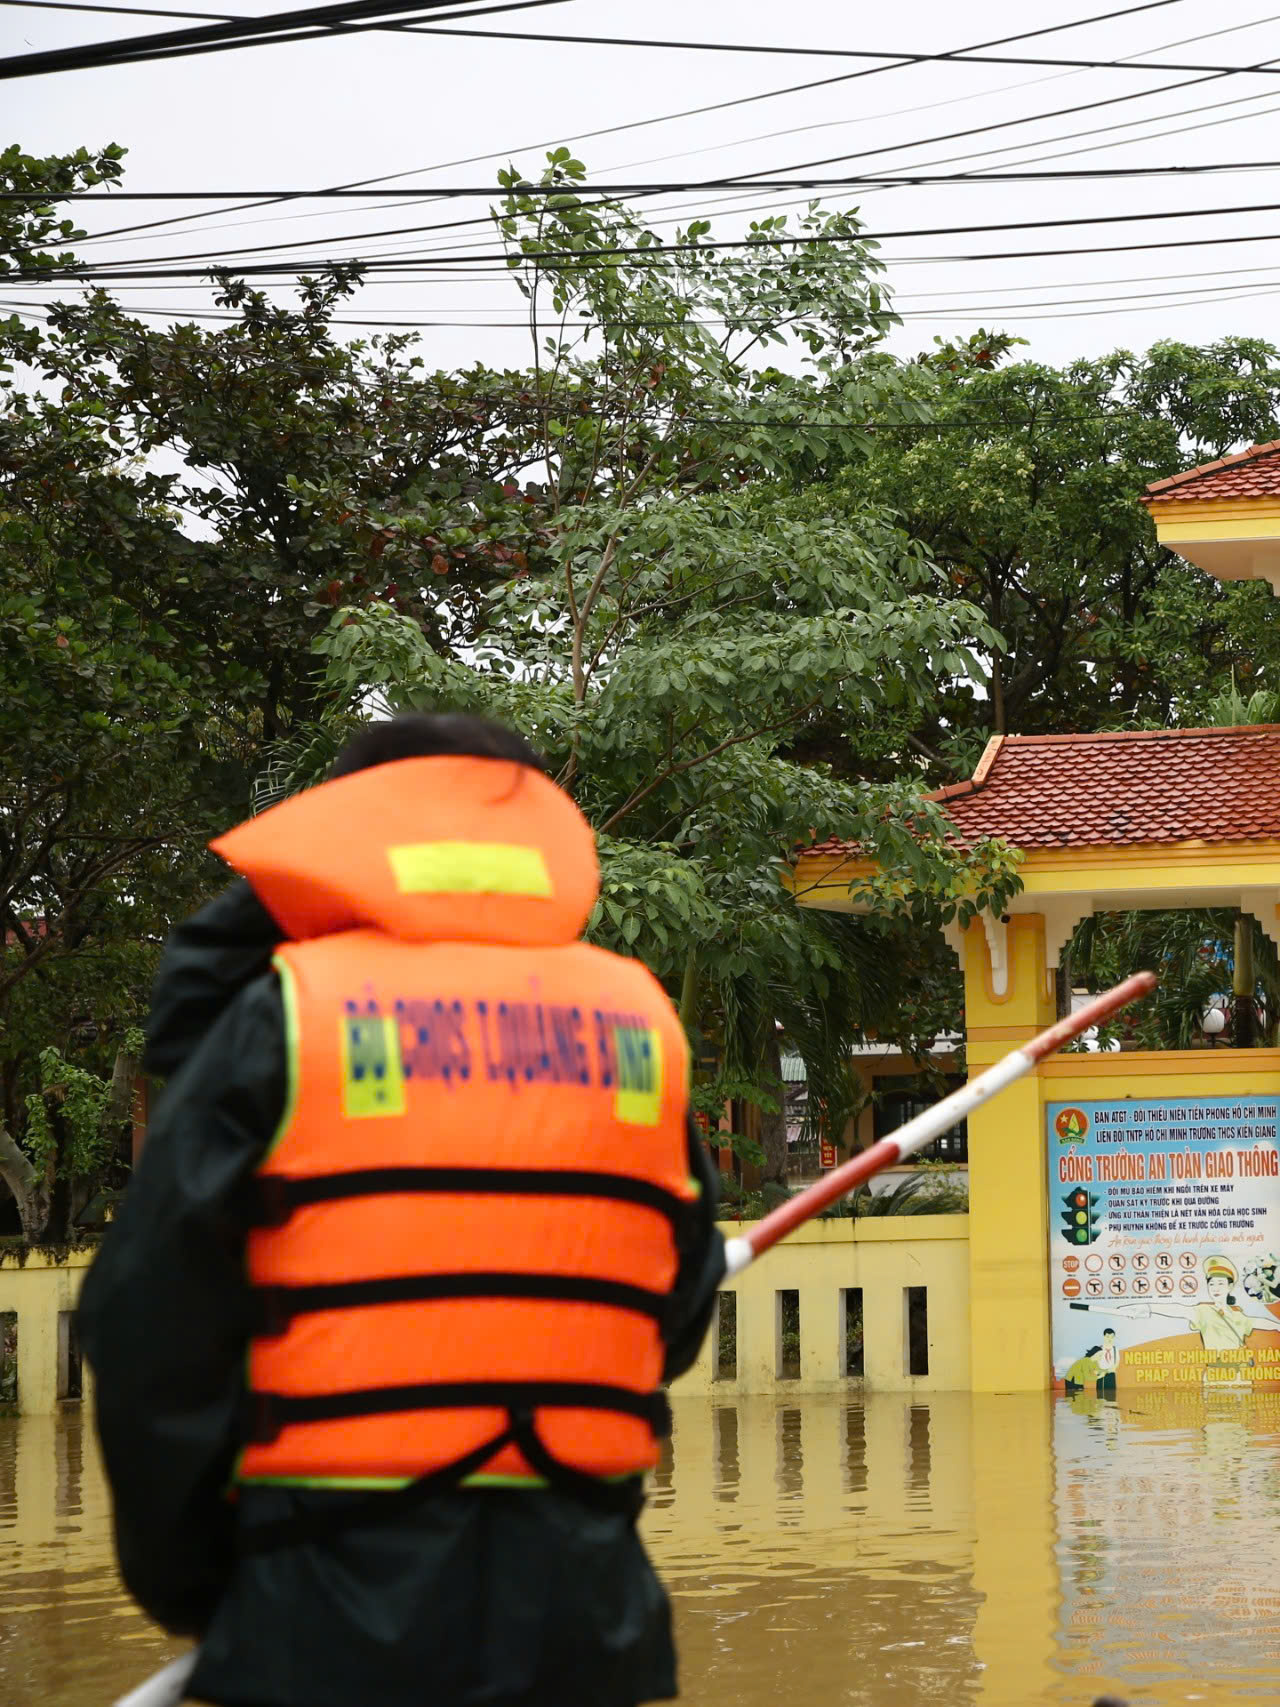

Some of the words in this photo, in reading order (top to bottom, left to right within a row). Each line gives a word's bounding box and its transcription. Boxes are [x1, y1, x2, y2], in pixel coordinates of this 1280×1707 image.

[1094, 1110, 1110, 1124] BAN
[1111, 1110, 1127, 1123] ATGT
[1206, 1107, 1230, 1120] PHONG
[1258, 1106, 1276, 1118] MINH
[1126, 1129, 1143, 1142] TNTP
[1169, 1128, 1187, 1141] MINH
[1218, 1127, 1236, 1139] THCS
[1255, 1125, 1276, 1138] GIANG
[1059, 1145, 1093, 1183] CỔNG
[1095, 1148, 1145, 1182] TRƯỜNG
[1148, 1153, 1165, 1180] AN
[1168, 1147, 1201, 1180] TOÀN
[1205, 1151, 1234, 1179] GIAO
[1237, 1145, 1279, 1178] THÔNG
[1164, 1186, 1175, 1194] KHI
[1210, 1185, 1219, 1193] XE
[1171, 1197, 1182, 1206] KHI
[1183, 1197, 1196, 1206] QUA
[1251, 1207, 1267, 1216] SINH
[1122, 1222, 1144, 1232] HUYNH
[1178, 1221, 1187, 1230] XE
[1063, 1259, 1079, 1269] STOP
[1207, 1367, 1236, 1382] GIAO
